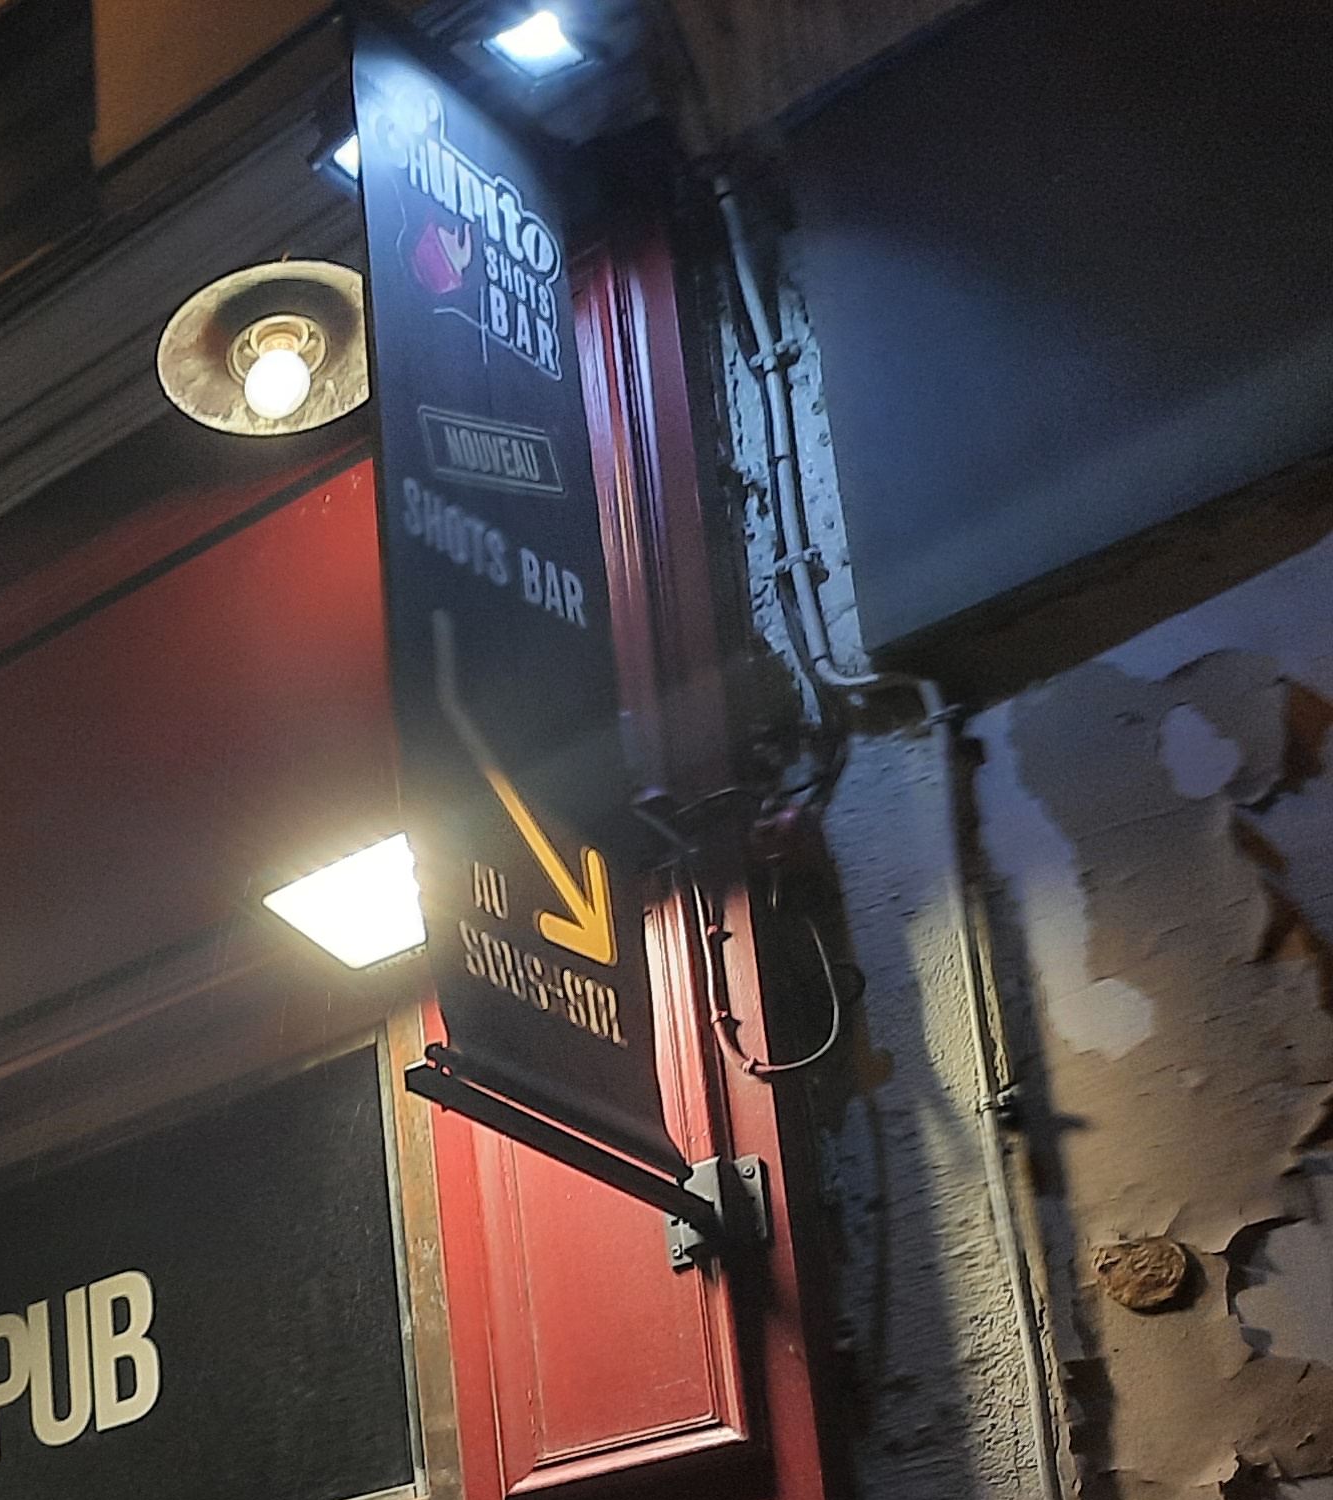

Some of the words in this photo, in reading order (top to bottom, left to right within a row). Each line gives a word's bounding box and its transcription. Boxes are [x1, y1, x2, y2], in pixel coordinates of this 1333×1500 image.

[485, 244, 552, 316] SHOTS
[489, 286, 555, 370] BAR
[444, 425, 540, 482] NOUVEAU
[403, 477, 510, 585] SHOTS
[520, 546, 586, 628] BAR
